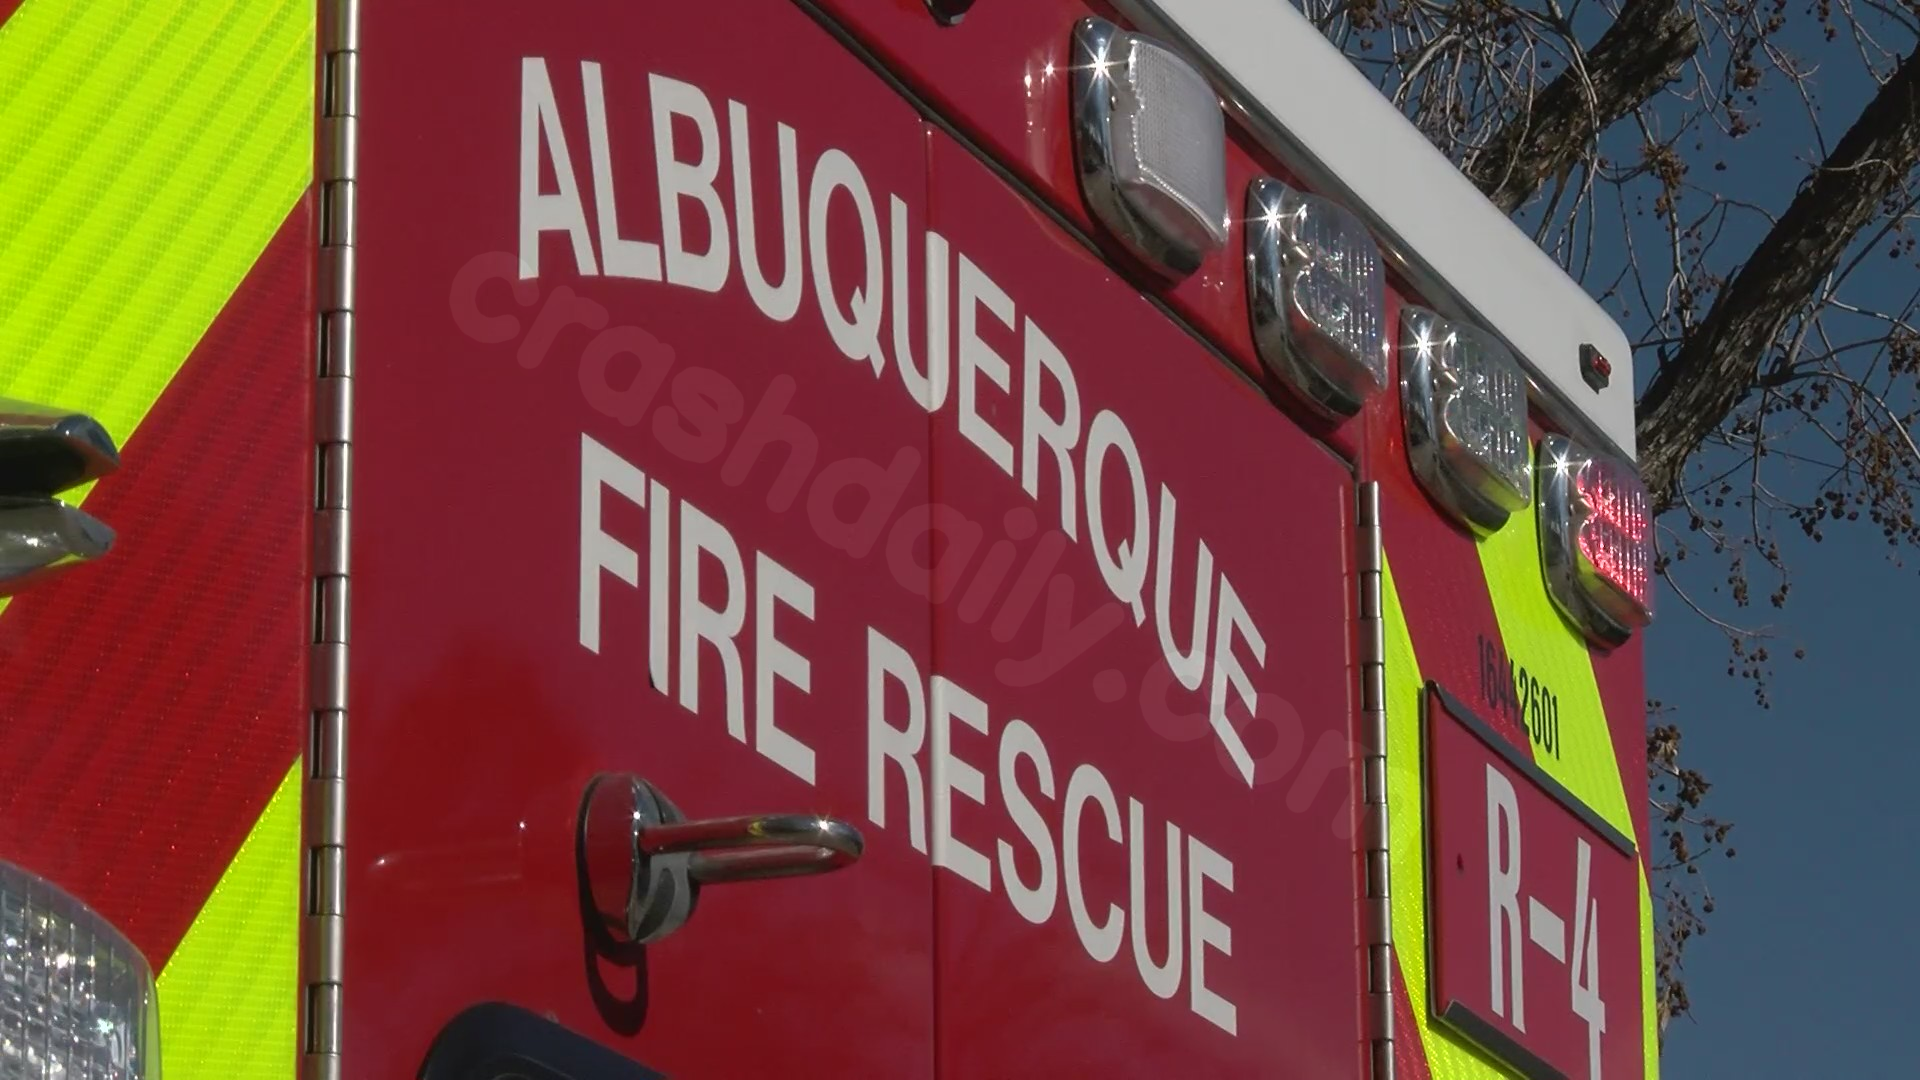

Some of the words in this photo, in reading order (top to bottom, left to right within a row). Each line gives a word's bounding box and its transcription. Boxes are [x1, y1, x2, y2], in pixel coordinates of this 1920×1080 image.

[518, 56, 1267, 789] ALBUQUERQUE
[579, 431, 816, 787] FIRE
[867, 625, 1238, 1037] RESCUE
[1486, 763, 1607, 1080] R-4
